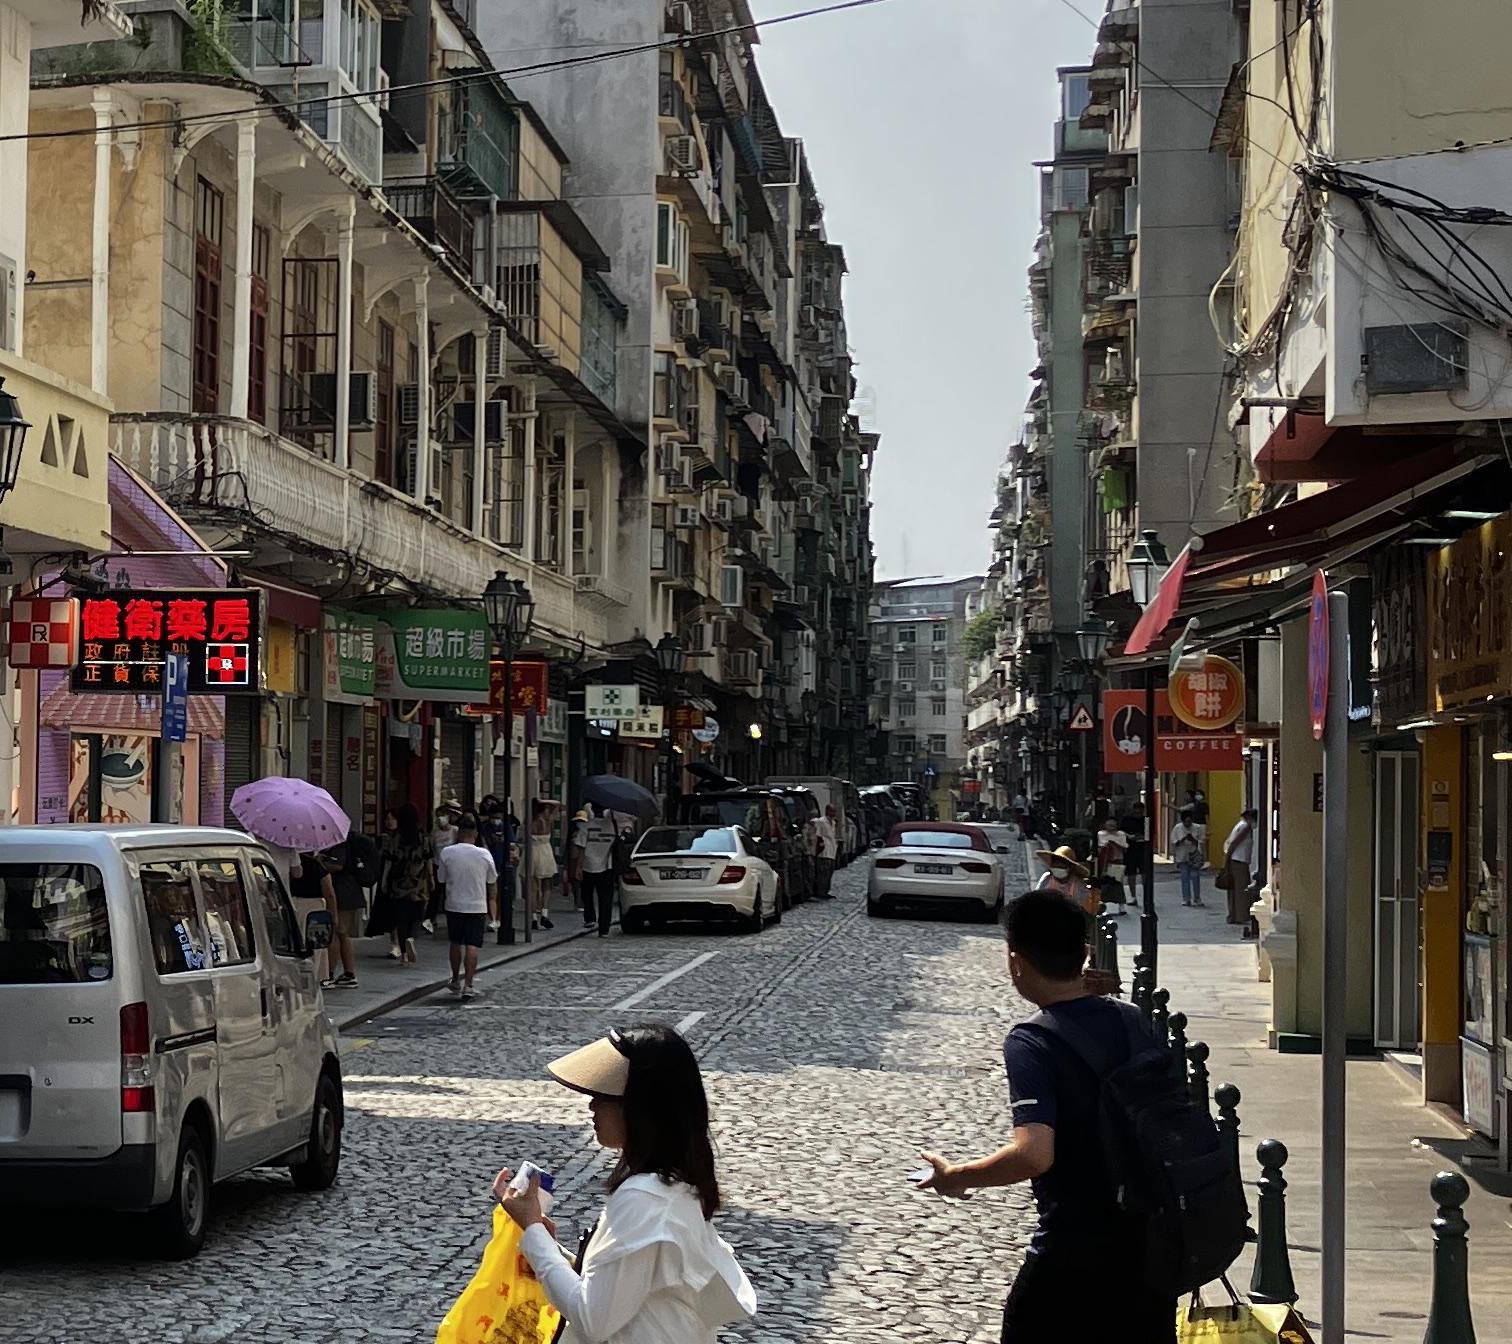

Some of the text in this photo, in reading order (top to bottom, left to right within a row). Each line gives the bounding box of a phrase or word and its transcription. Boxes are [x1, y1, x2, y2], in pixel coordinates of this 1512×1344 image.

[81, 598, 250, 641] 健衛藥房
[405, 627, 486, 661] 超級市場
[83, 664, 161, 684] 正貨保
[403, 665, 485, 679] SUPERMARKET
[1163, 740, 1230, 751] COFFEE
[68, 1016, 95, 1025] DX
